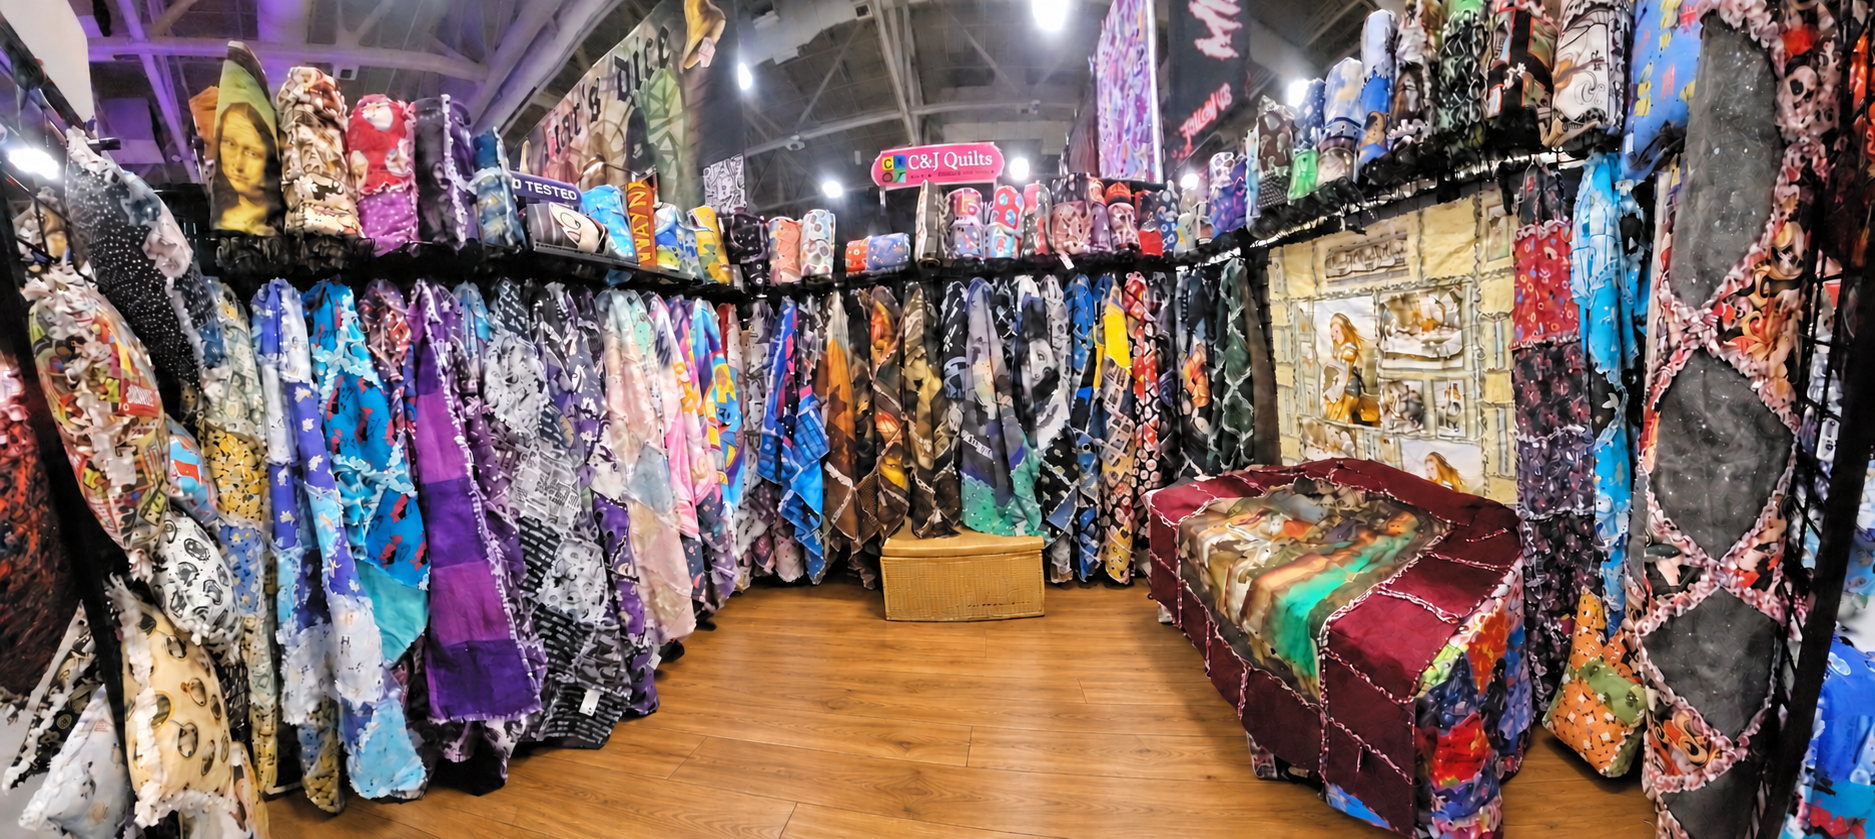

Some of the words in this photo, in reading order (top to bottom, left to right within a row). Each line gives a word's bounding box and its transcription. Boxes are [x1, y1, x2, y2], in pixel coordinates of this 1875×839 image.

[908, 151, 939, 171] C&J
[943, 150, 993, 170] Quilts
[525, 181, 577, 201] TESTED
